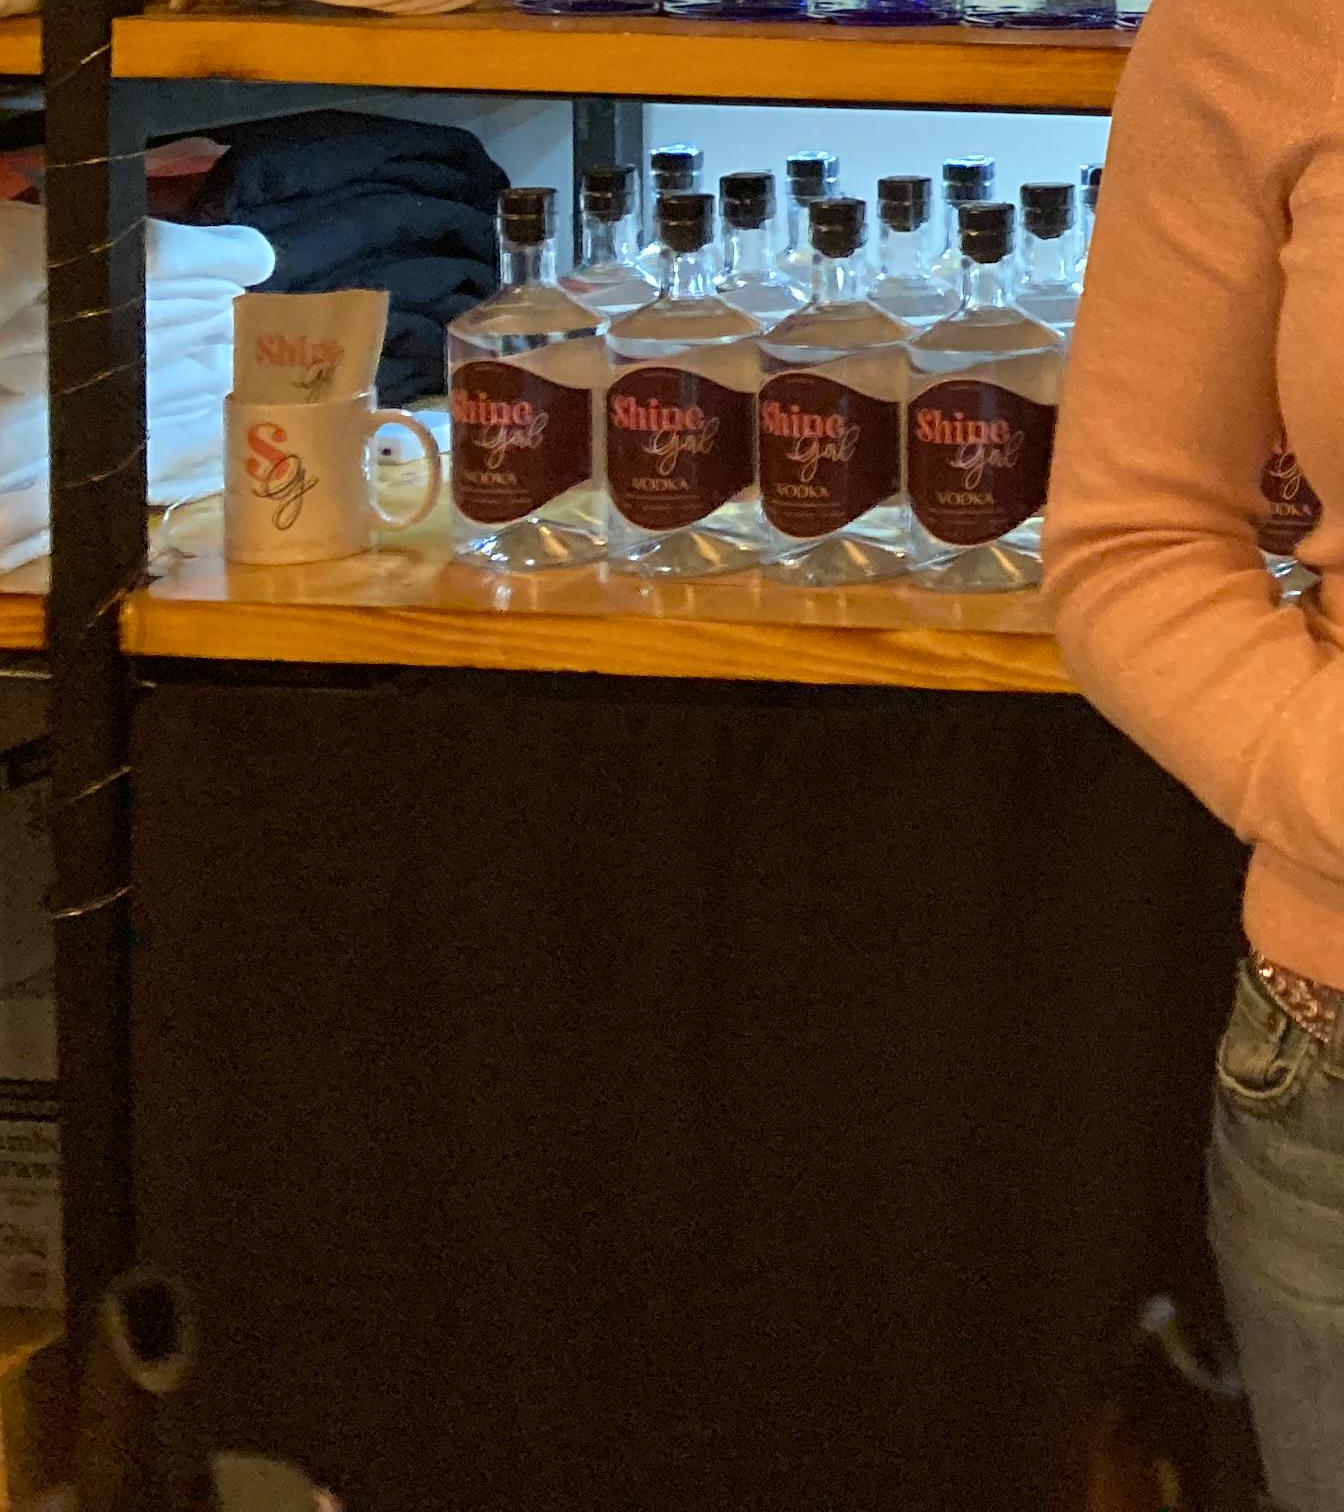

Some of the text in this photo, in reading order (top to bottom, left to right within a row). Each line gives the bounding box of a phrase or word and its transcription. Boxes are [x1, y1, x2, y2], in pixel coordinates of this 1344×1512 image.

[453, 391, 533, 425] Shine
[612, 394, 705, 431] Shine
[762, 401, 846, 437] Shine
[916, 407, 1011, 444] Shine
